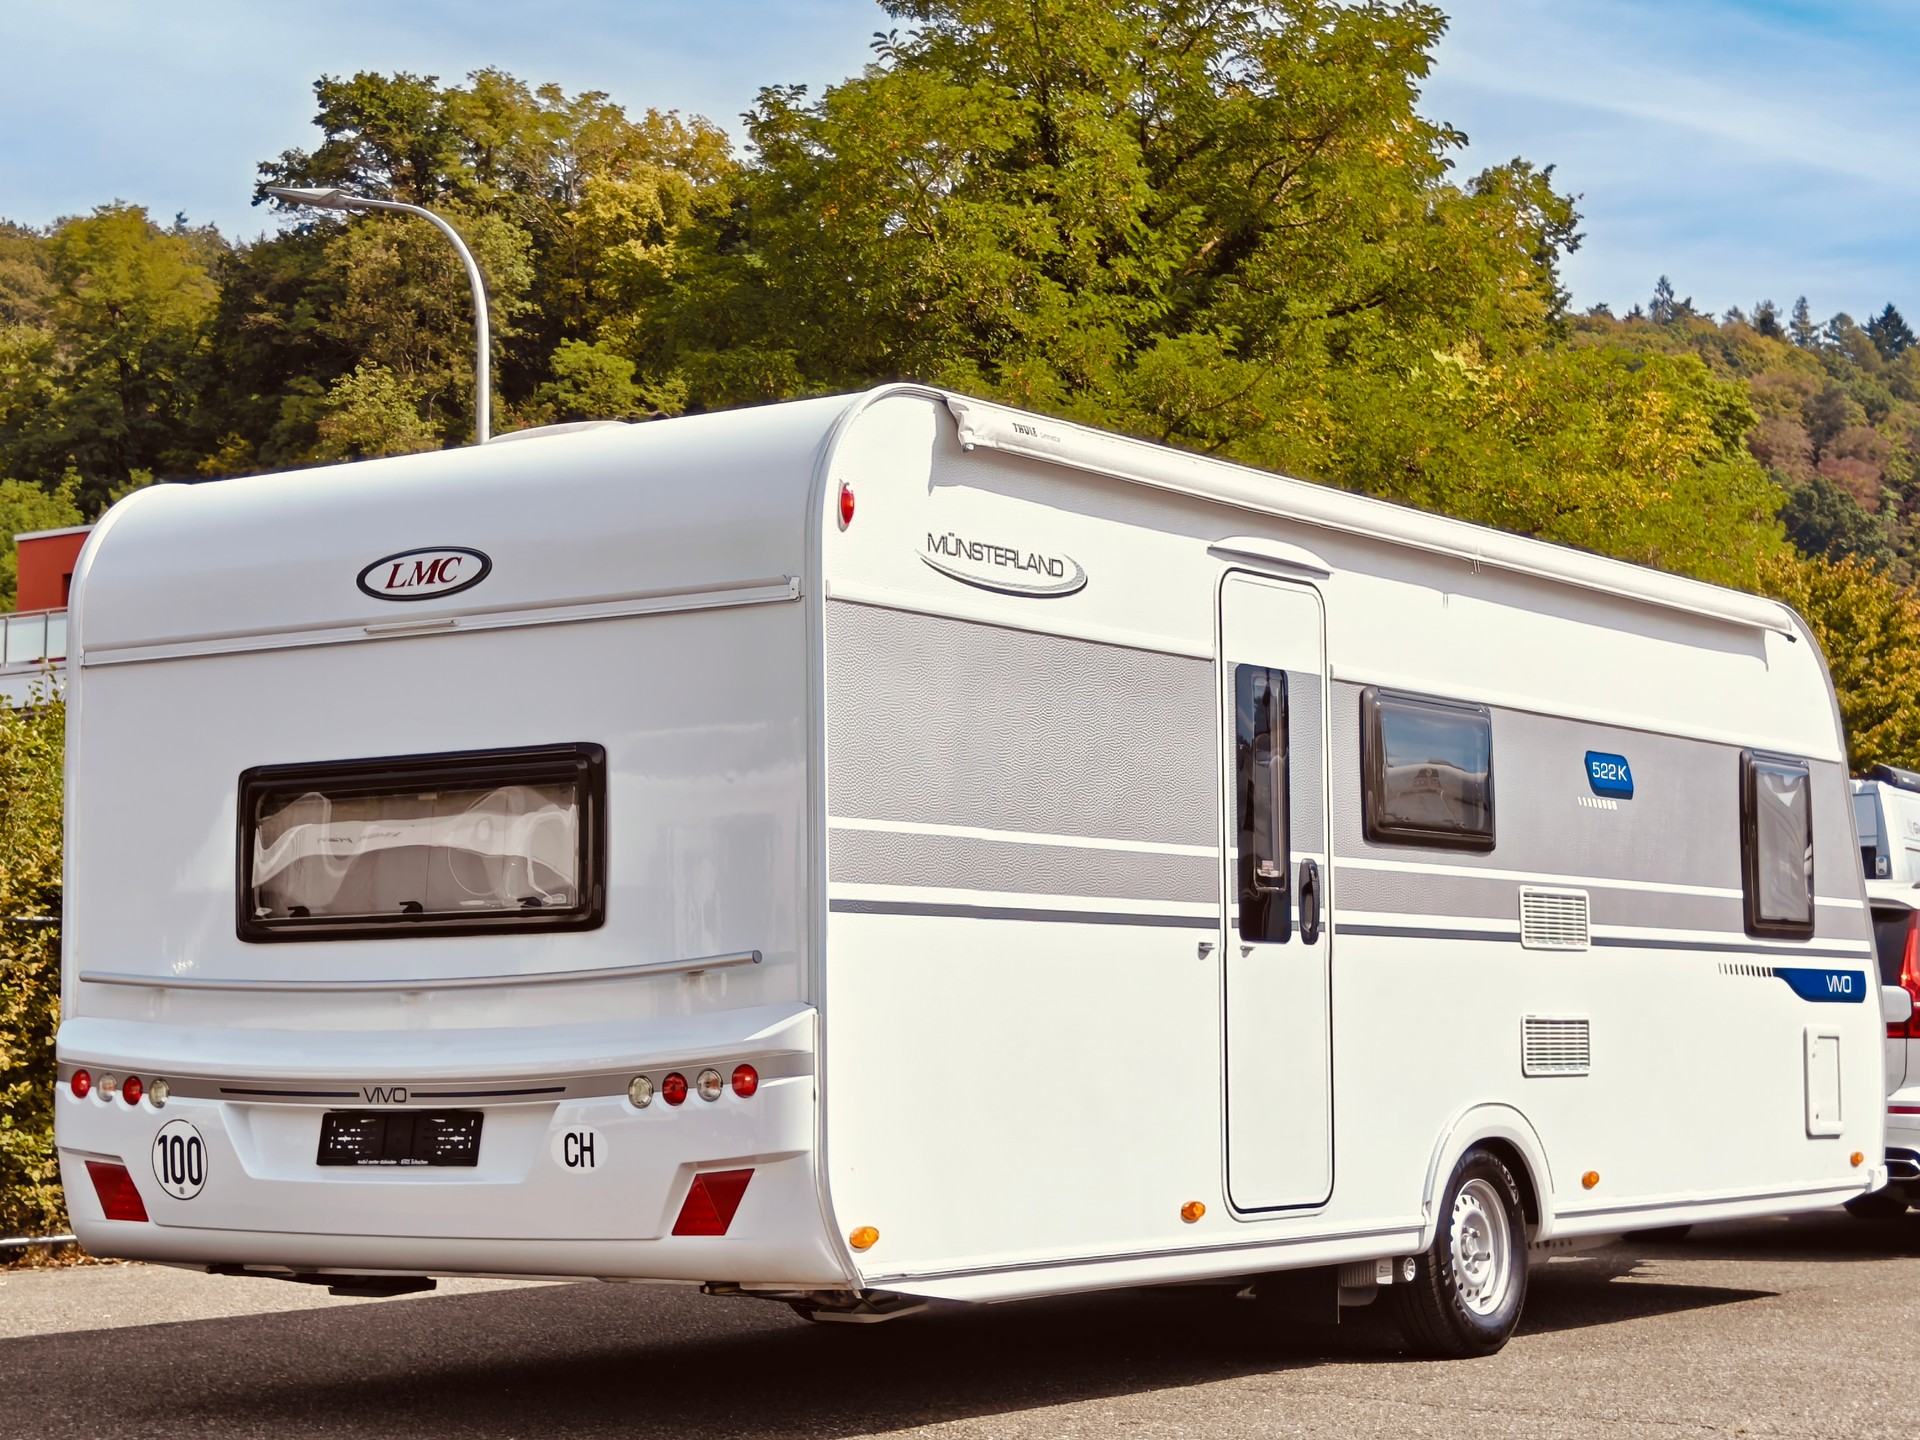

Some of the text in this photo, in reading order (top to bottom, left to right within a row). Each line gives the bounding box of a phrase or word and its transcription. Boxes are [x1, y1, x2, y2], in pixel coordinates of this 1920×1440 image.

[927, 532, 1064, 578] MÜNSTERLAND
[384, 556, 463, 589] LMC
[1825, 974, 1852, 993] VIVO
[362, 1086, 407, 1104] VIVO
[157, 1134, 203, 1186] 100
[564, 1132, 595, 1168] CH
